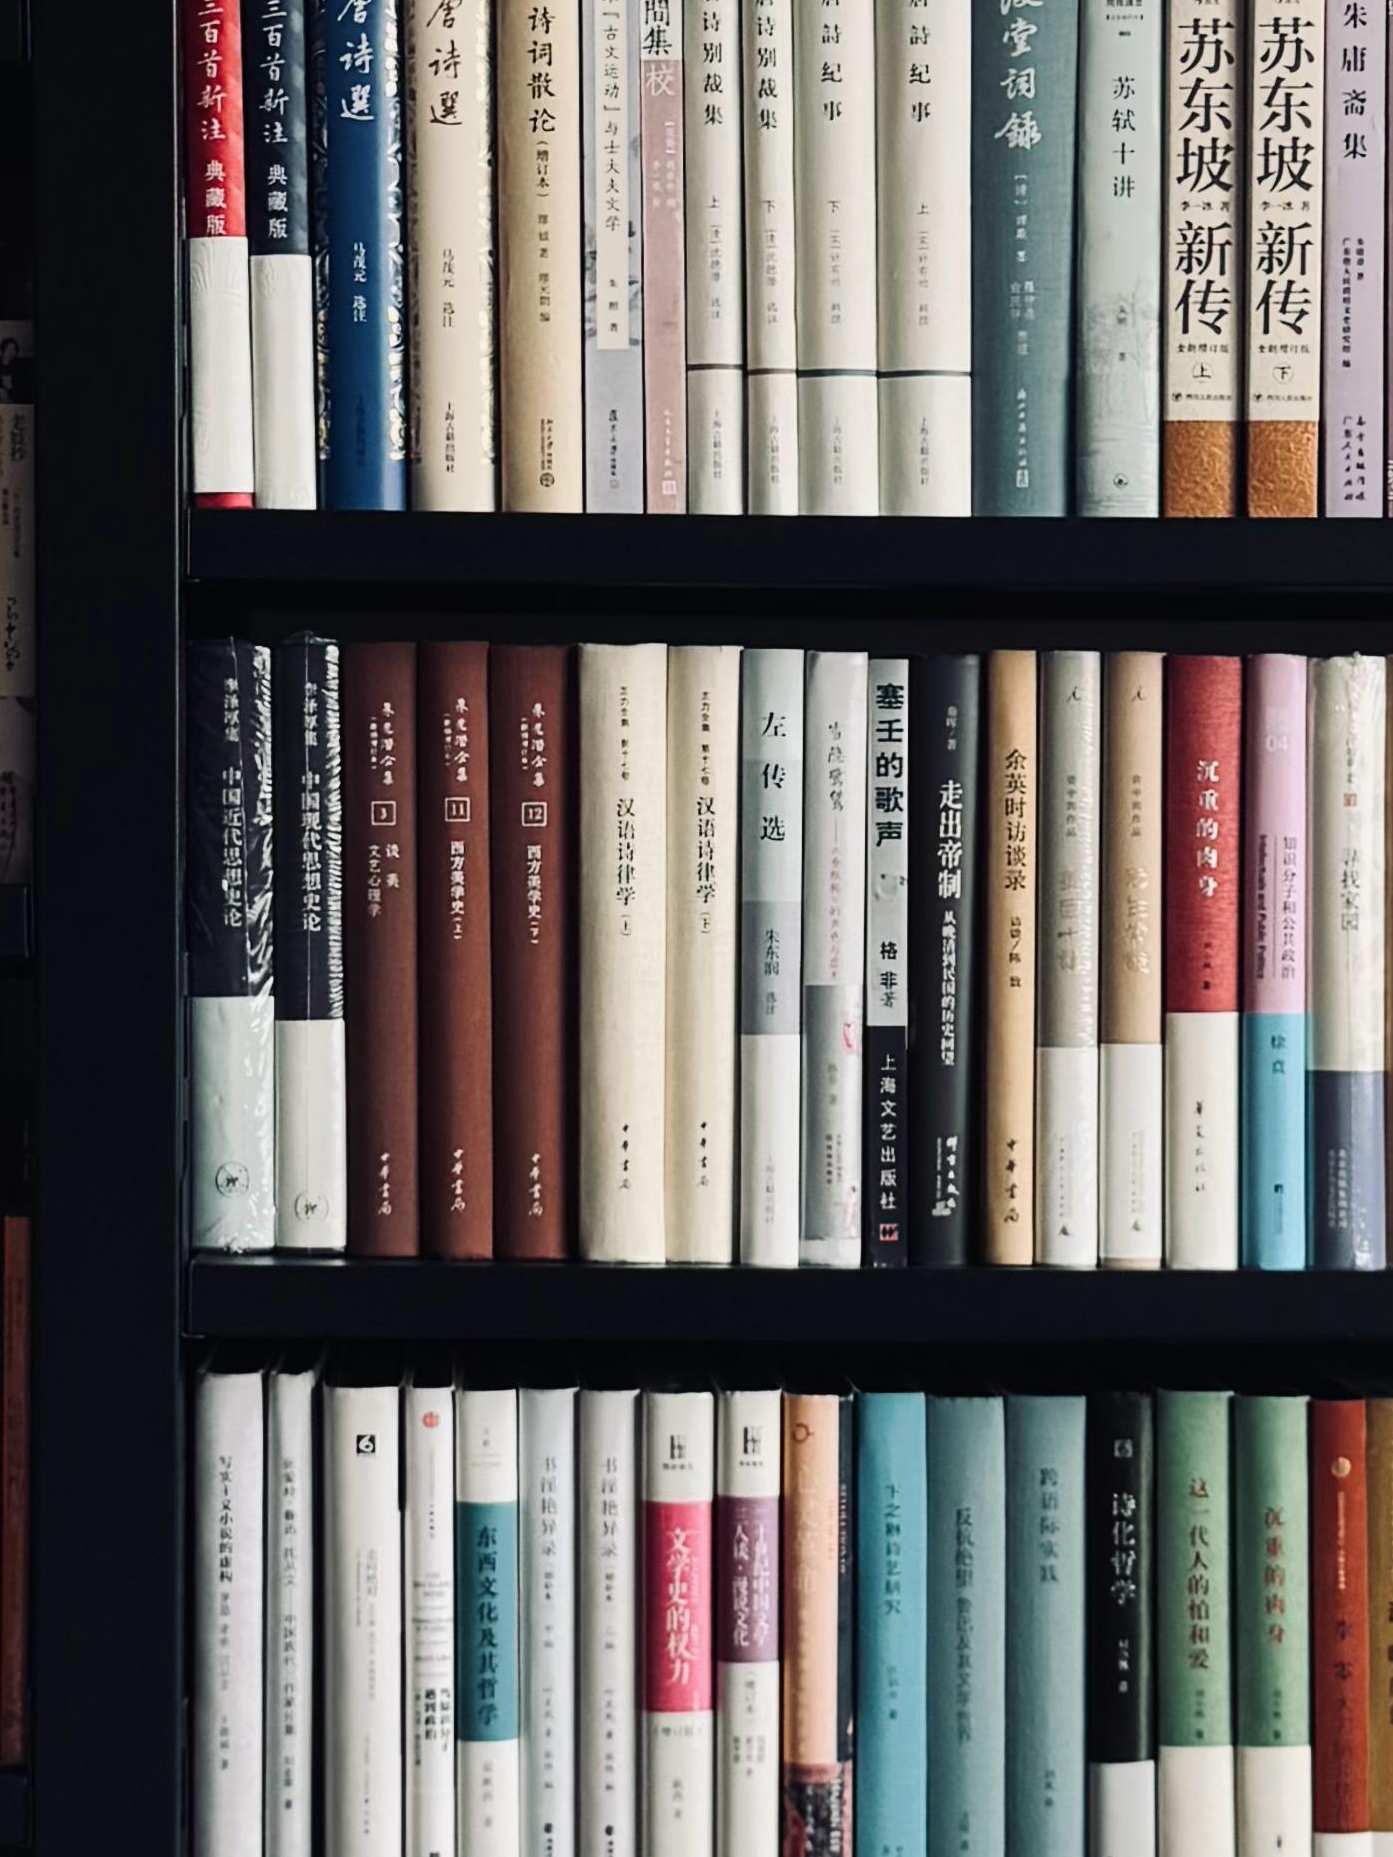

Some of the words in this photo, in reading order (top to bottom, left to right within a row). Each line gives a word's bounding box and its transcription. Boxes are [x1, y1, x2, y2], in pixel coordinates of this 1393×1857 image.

[527, 6, 557, 133] 诗词散论
[1111, 76, 1136, 199] 苏轼十讲
[1176, 16, 1235, 194] 苏东坡
[1341, 2, 1368, 160] 朱庸斋集
[205, 160, 227, 237] 典藏版
[1174, 220, 1234, 337] 新传
[760, 711, 787, 842] 左传选
[874, 683, 905, 847] 塞壬的歌声
[1003, 749, 1028, 892] 余英时访谈录
[1195, 759, 1221, 897] 沉重的肉身
[222, 770, 243, 929] 中国近代思想史论
[301, 771, 322, 933] 中国现代思想史论
[616, 797, 637, 907] 汉语诗律学
[937, 780, 963, 899] 走出帝制
[880, 1053, 897, 1210] 上海文艺出版社
[666, 1528, 690, 1685] 文学史的权力
[1111, 1493, 1137, 1604] 诗化哲学
[1188, 1477, 1210, 1670] 这一代人的怕和爱
[477, 1525, 499, 1727] 东西文化及其哲学
